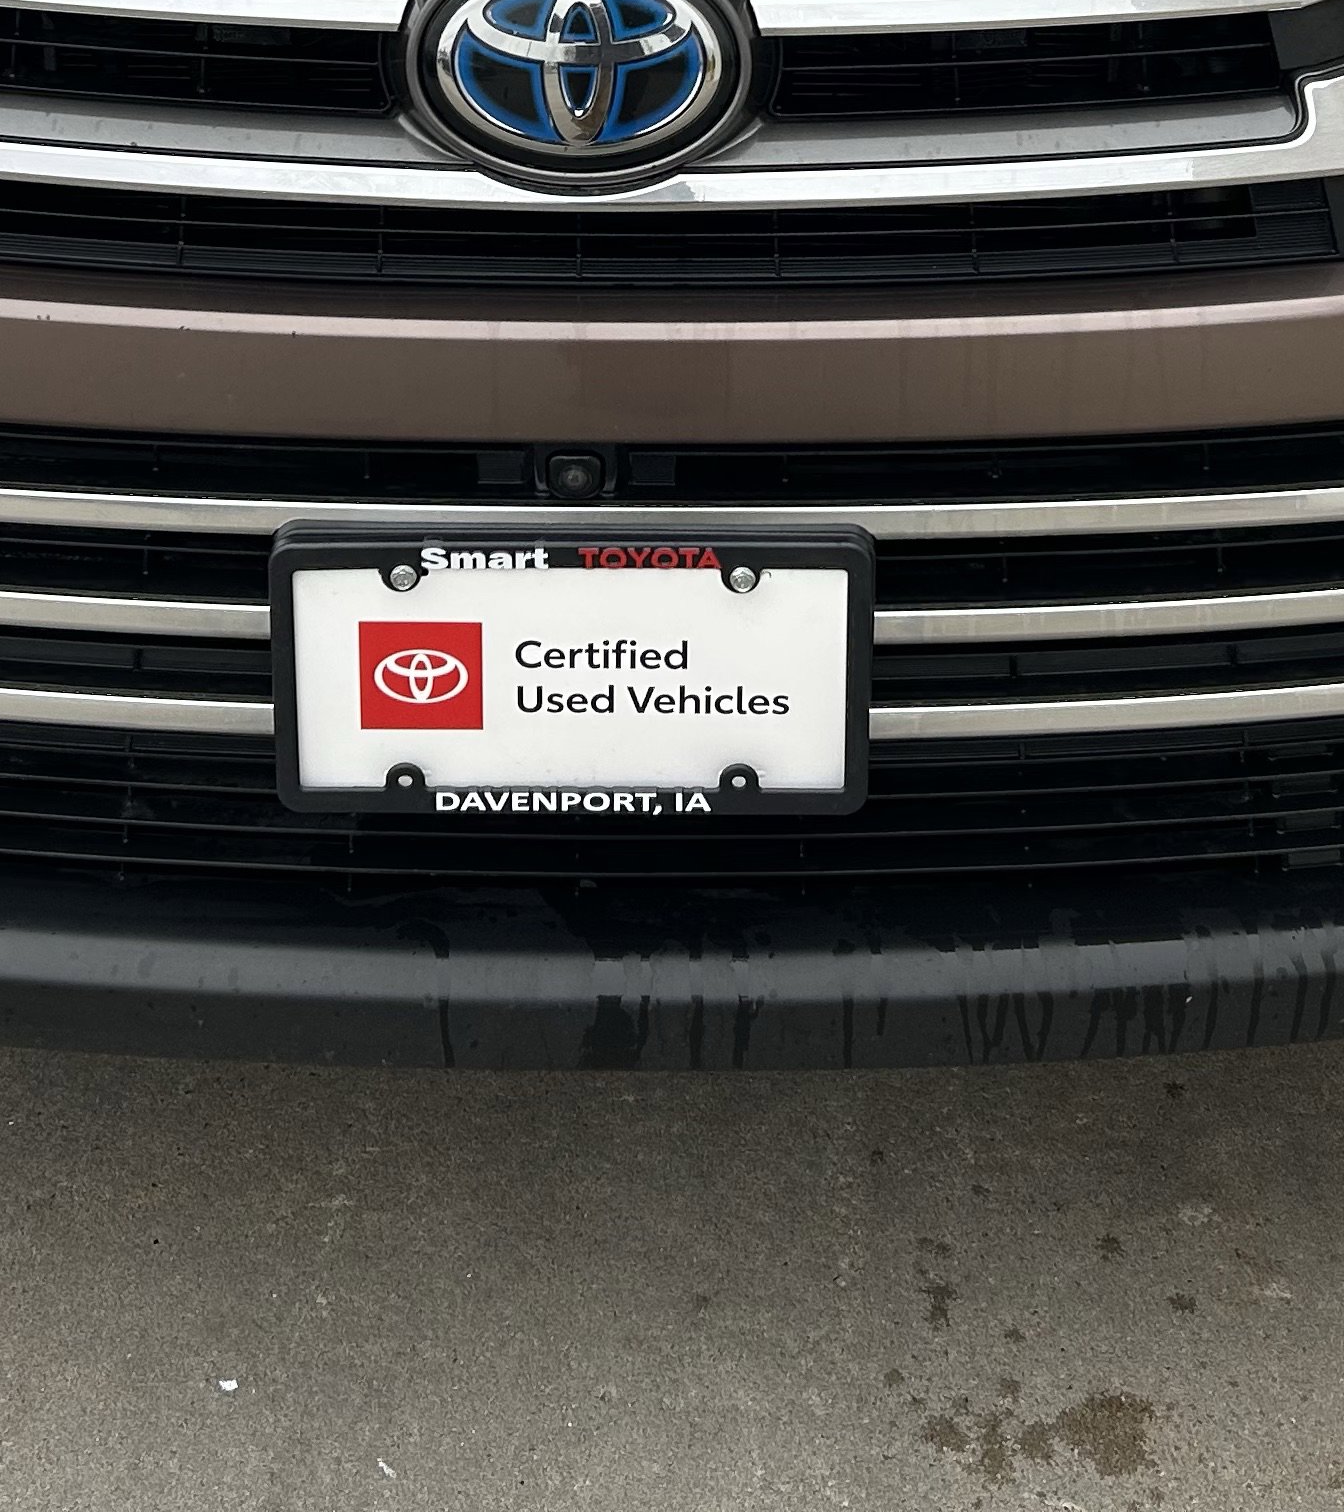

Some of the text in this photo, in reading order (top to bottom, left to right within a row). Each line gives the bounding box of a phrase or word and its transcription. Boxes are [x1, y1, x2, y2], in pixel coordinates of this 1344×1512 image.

[420, 547, 722, 569] Smart TOYOTA
[515, 639, 688, 670] Certified
[516, 684, 790, 715] Used Vehicles
[435, 791, 712, 816] DAVENPORT, IA
